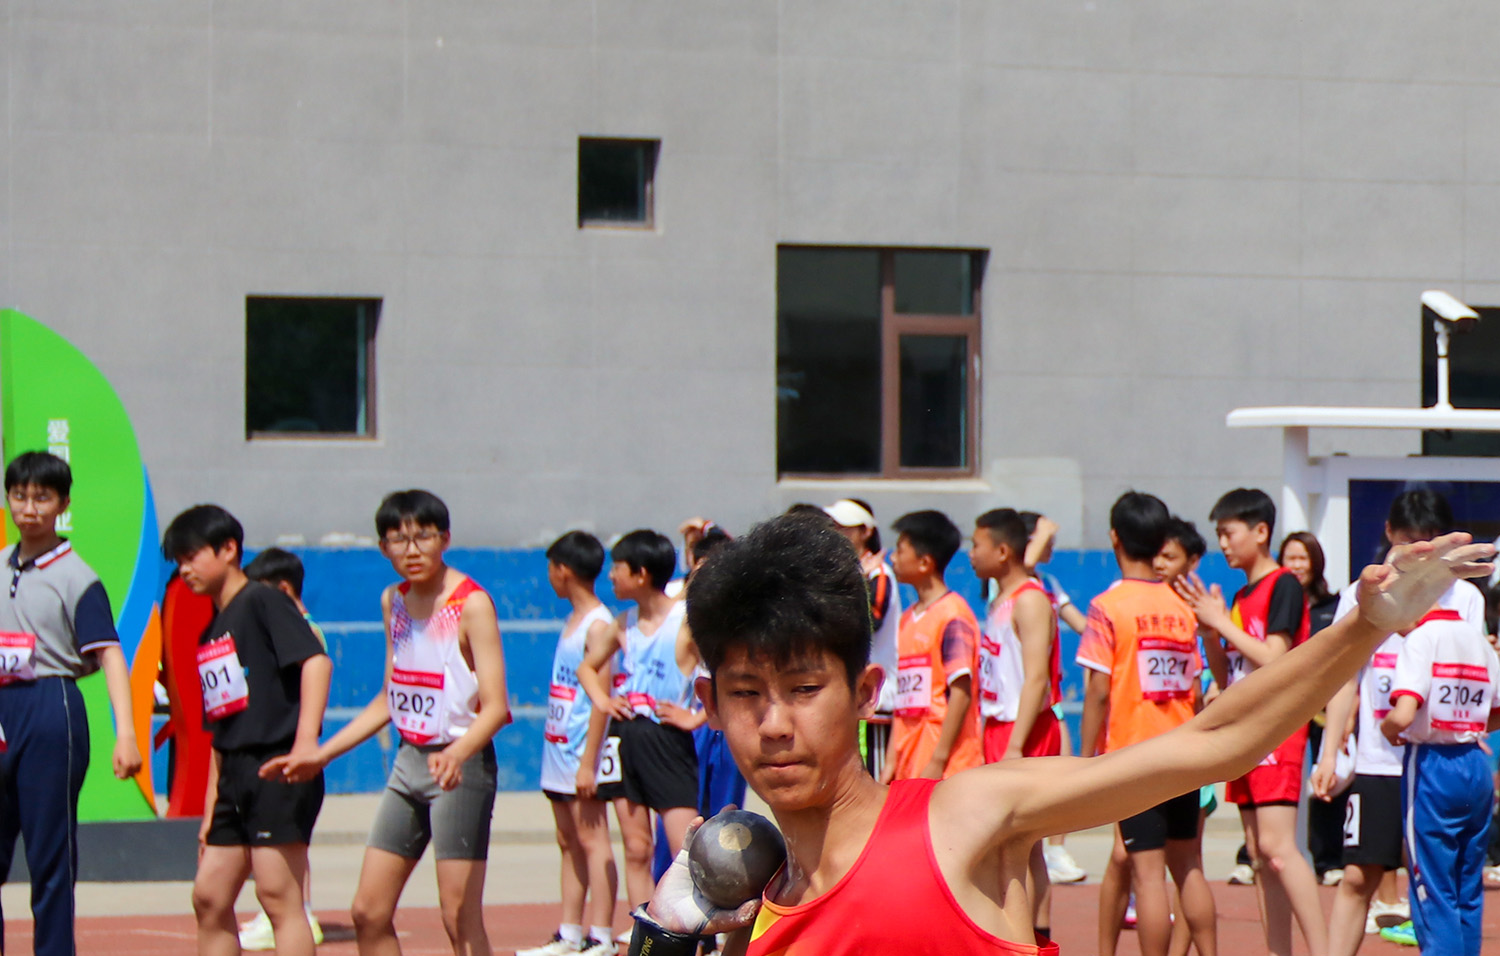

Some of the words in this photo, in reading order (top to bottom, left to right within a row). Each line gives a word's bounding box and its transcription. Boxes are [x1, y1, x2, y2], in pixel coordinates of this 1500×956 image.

[1147, 656, 1188, 676] 2127
[390, 689, 435, 718] 1202
[1438, 684, 1485, 707] 2704
